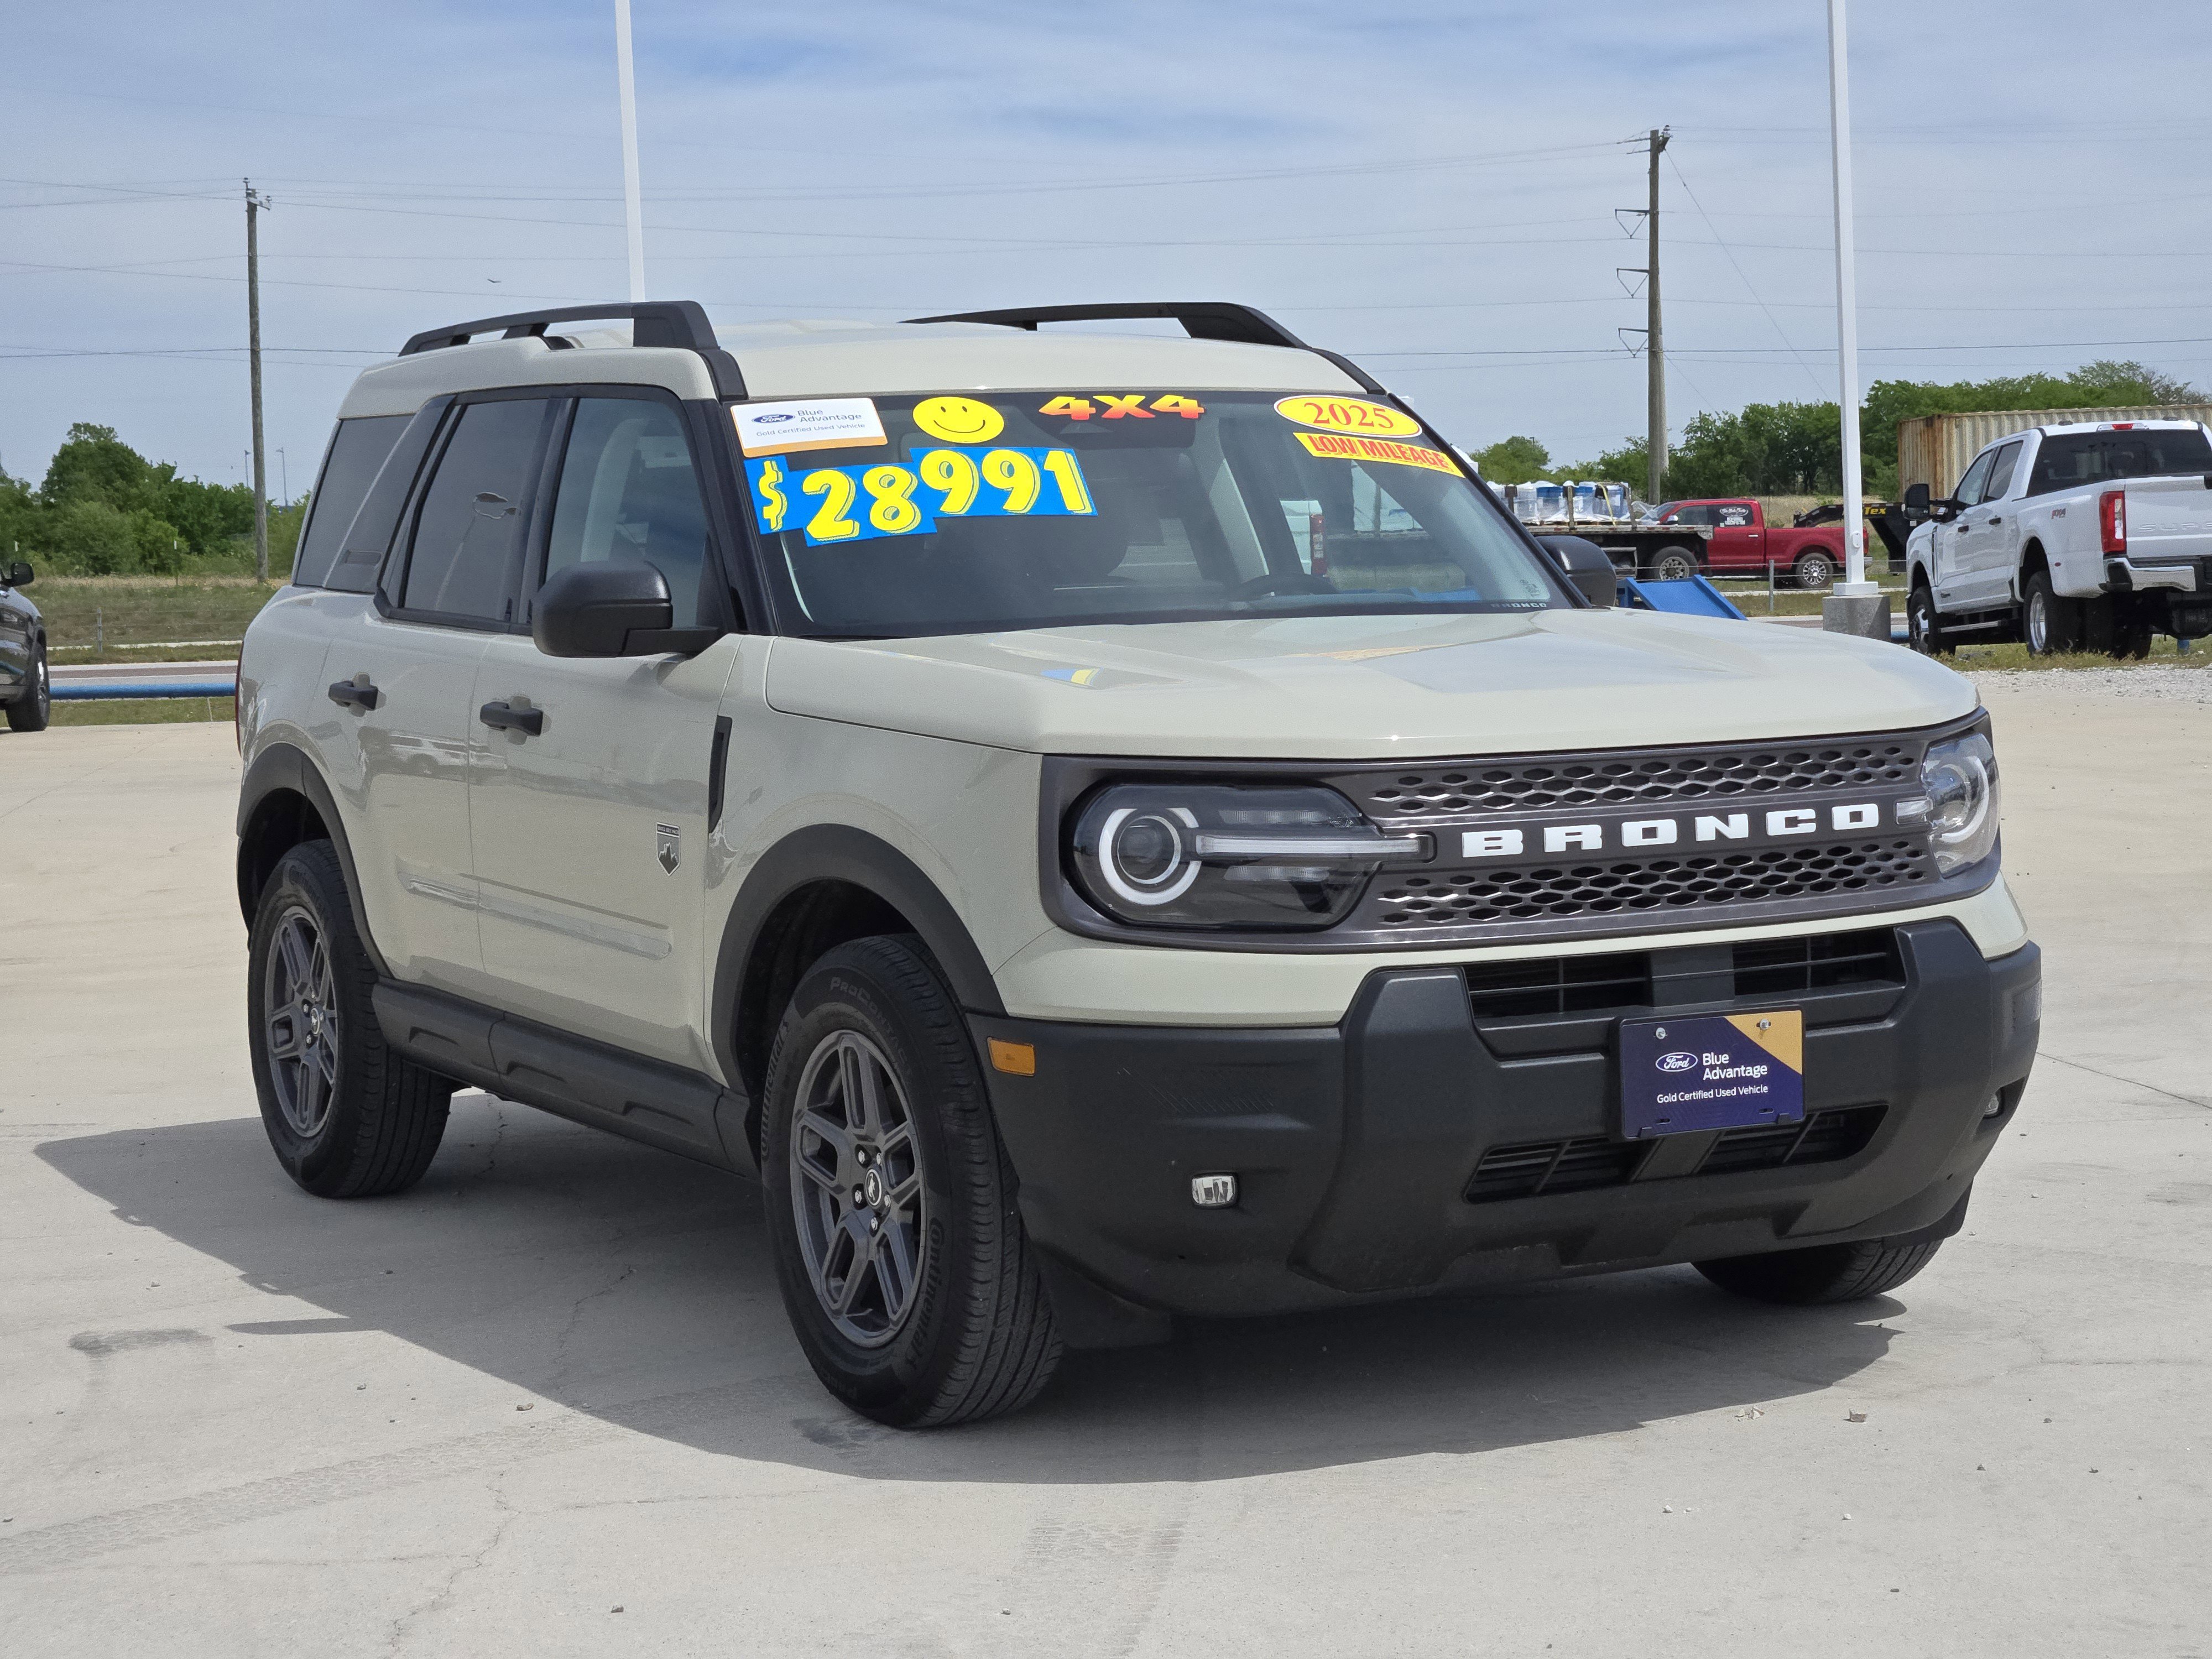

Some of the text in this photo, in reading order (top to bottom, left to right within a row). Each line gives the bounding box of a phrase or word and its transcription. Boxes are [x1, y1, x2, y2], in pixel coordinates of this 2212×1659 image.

[1039, 395, 1204, 420] 4X4
[1304, 402, 1394, 429] 2025
[800, 414, 862, 422] Advantage
[1307, 435, 1450, 469] LOW MILEAGE
[1864, 507, 1887, 515] Tex
[1461, 803, 1880, 858] BRONCO
[1663, 1055, 1690, 1070] Ford
[1703, 1052, 1729, 1066] Blue
[1703, 1065, 1768, 1081] Advantage
[1657, 1084, 1768, 1104] Gold Certified Used Vehicle
